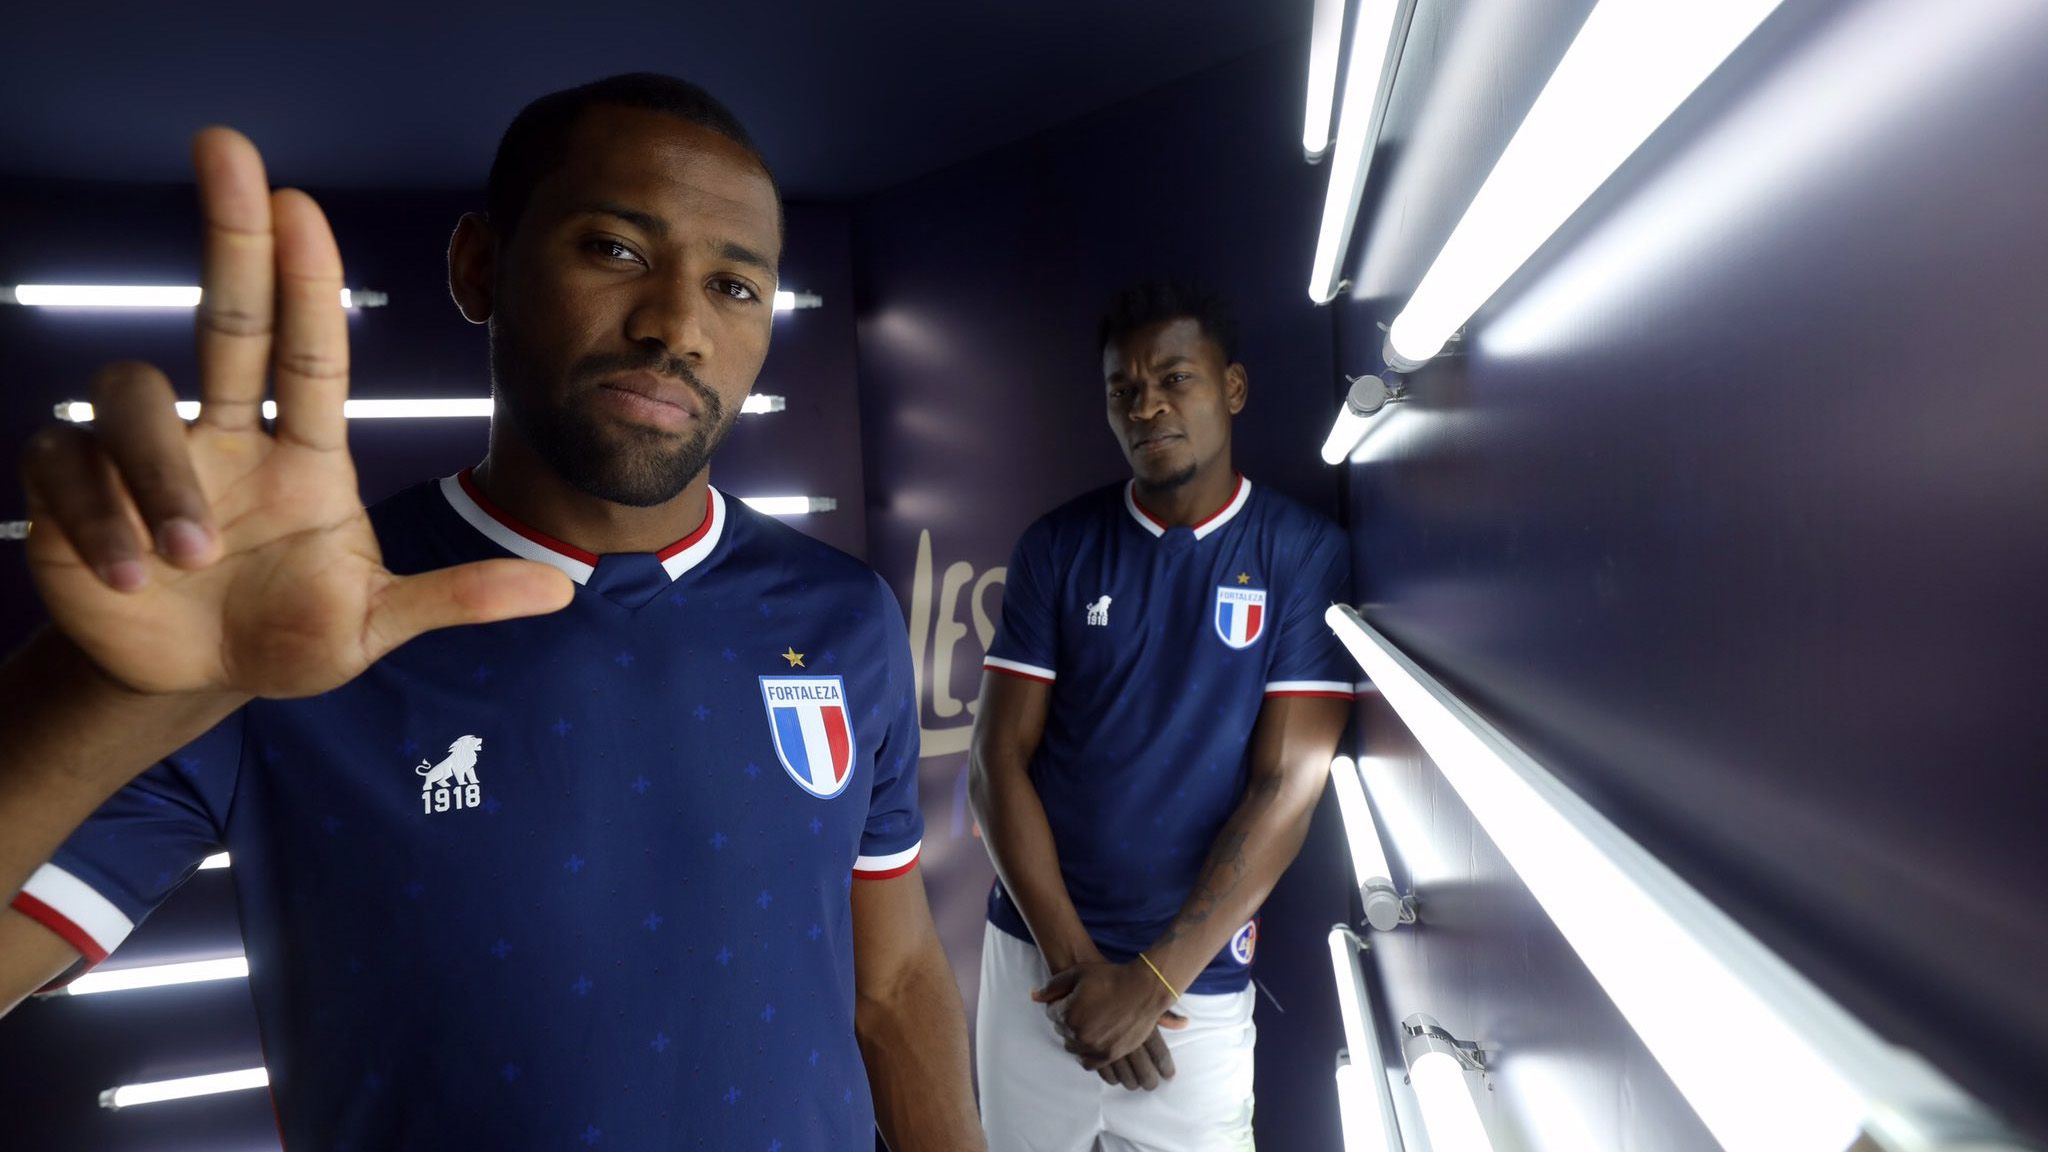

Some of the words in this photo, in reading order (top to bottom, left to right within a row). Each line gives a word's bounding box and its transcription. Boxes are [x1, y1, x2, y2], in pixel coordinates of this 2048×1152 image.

[1220, 591, 1263, 601] FORTALEZA
[1087, 615, 1108, 626] 1918
[767, 685, 840, 700] FORTALEZA
[421, 784, 481, 815] 1918
